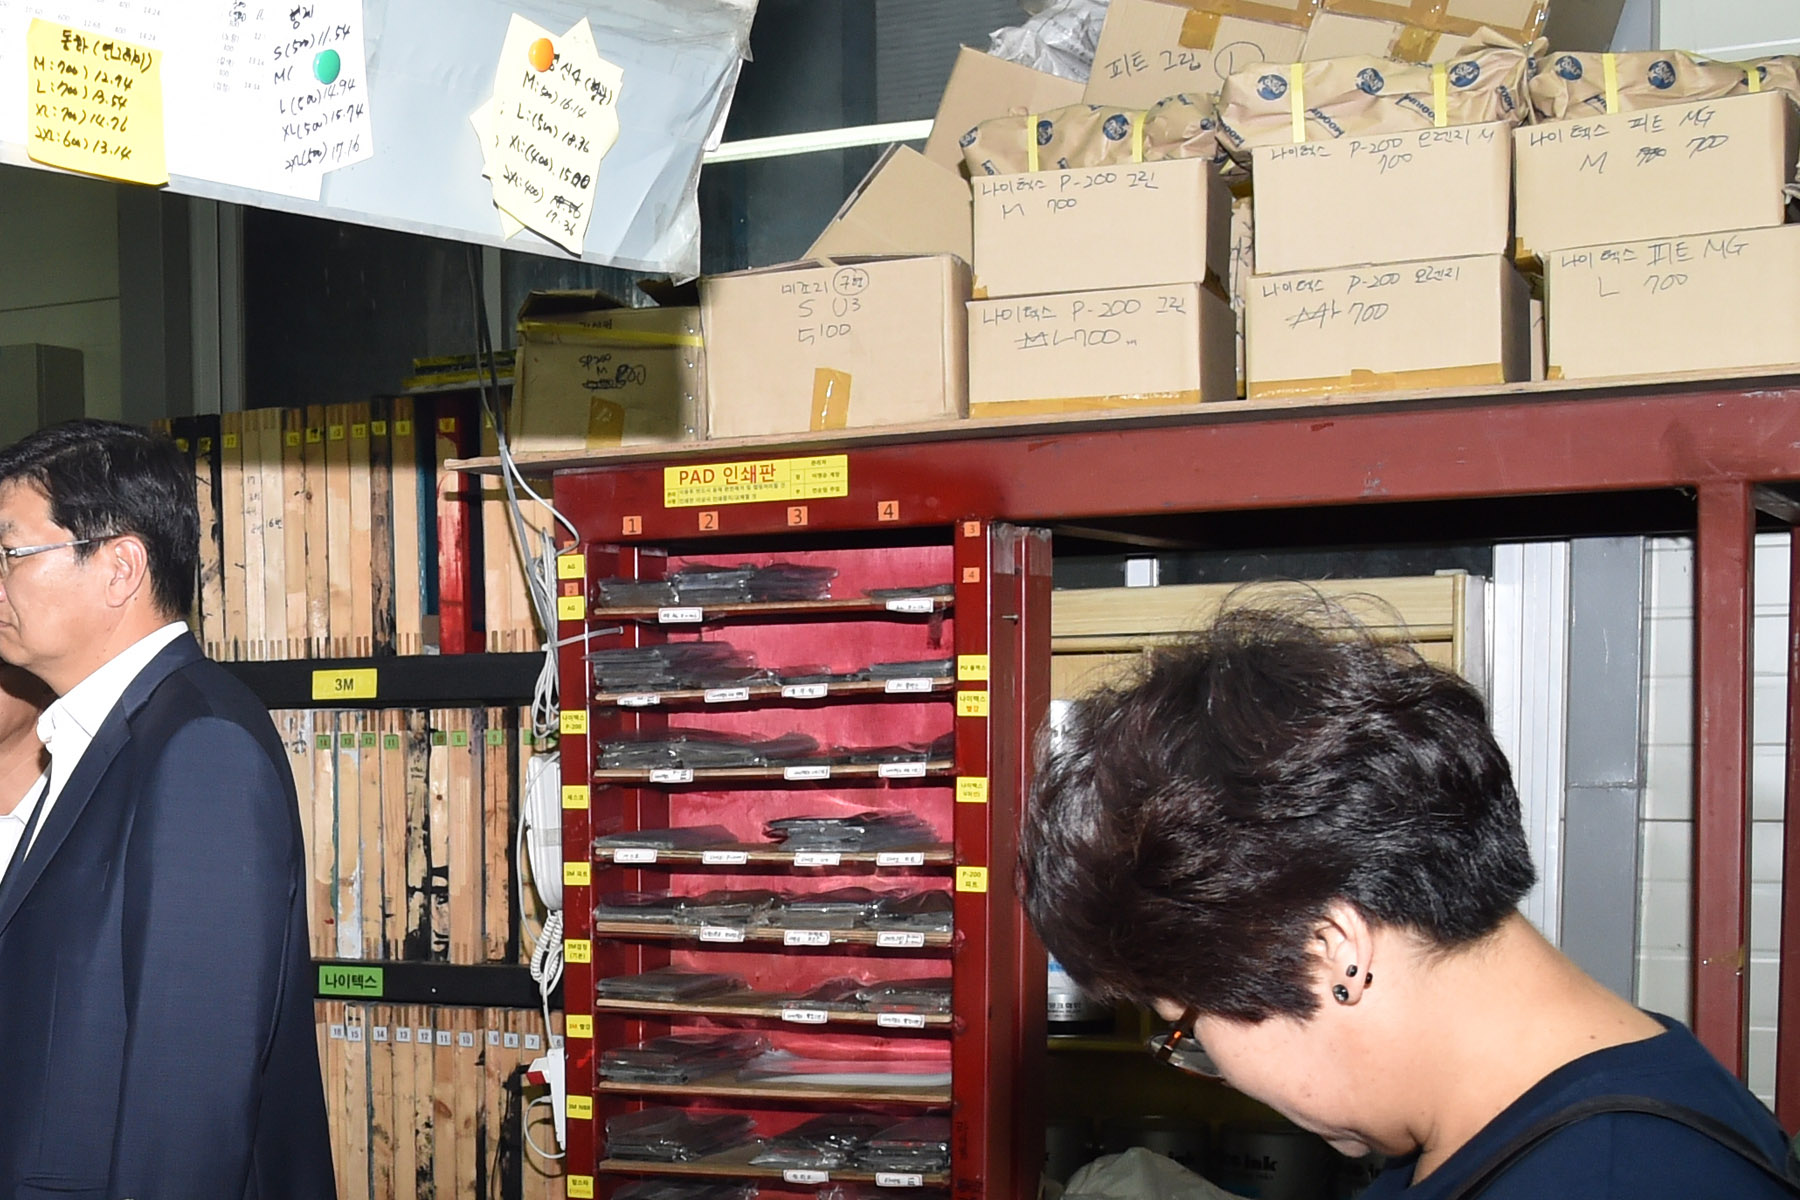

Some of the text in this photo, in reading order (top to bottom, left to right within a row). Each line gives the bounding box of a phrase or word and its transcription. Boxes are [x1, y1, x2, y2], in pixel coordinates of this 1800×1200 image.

[679, 463, 777, 486] PAD 인쇄판
[628, 504, 894, 534] 1 2 3 4
[334, 677, 354, 692] 3M
[324, 973, 377, 990] 나이텍스
